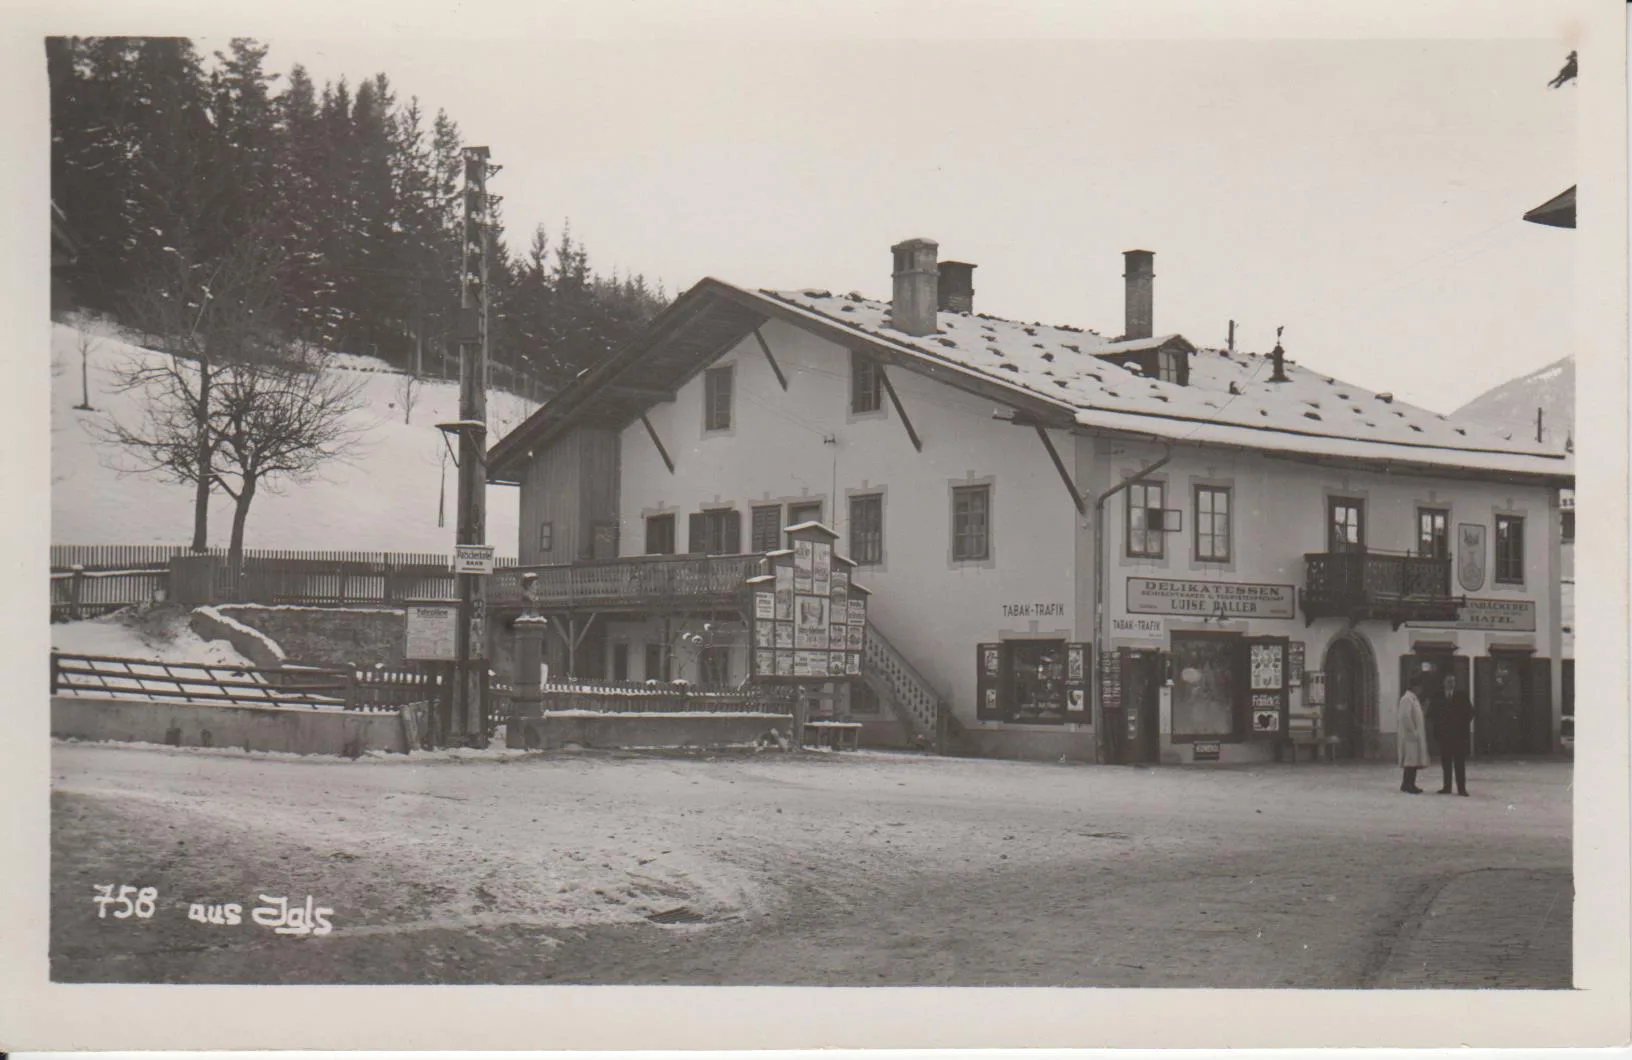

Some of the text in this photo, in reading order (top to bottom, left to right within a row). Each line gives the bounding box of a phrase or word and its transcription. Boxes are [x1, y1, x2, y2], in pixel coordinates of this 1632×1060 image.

[1145, 581, 1280, 596] DELIKATESSEN
[1002, 603, 1065, 617] TABAK-TRAFIK
[1171, 599, 1206, 611] LUISE
[1112, 619, 1161, 632] TABAK-TRAFIK
